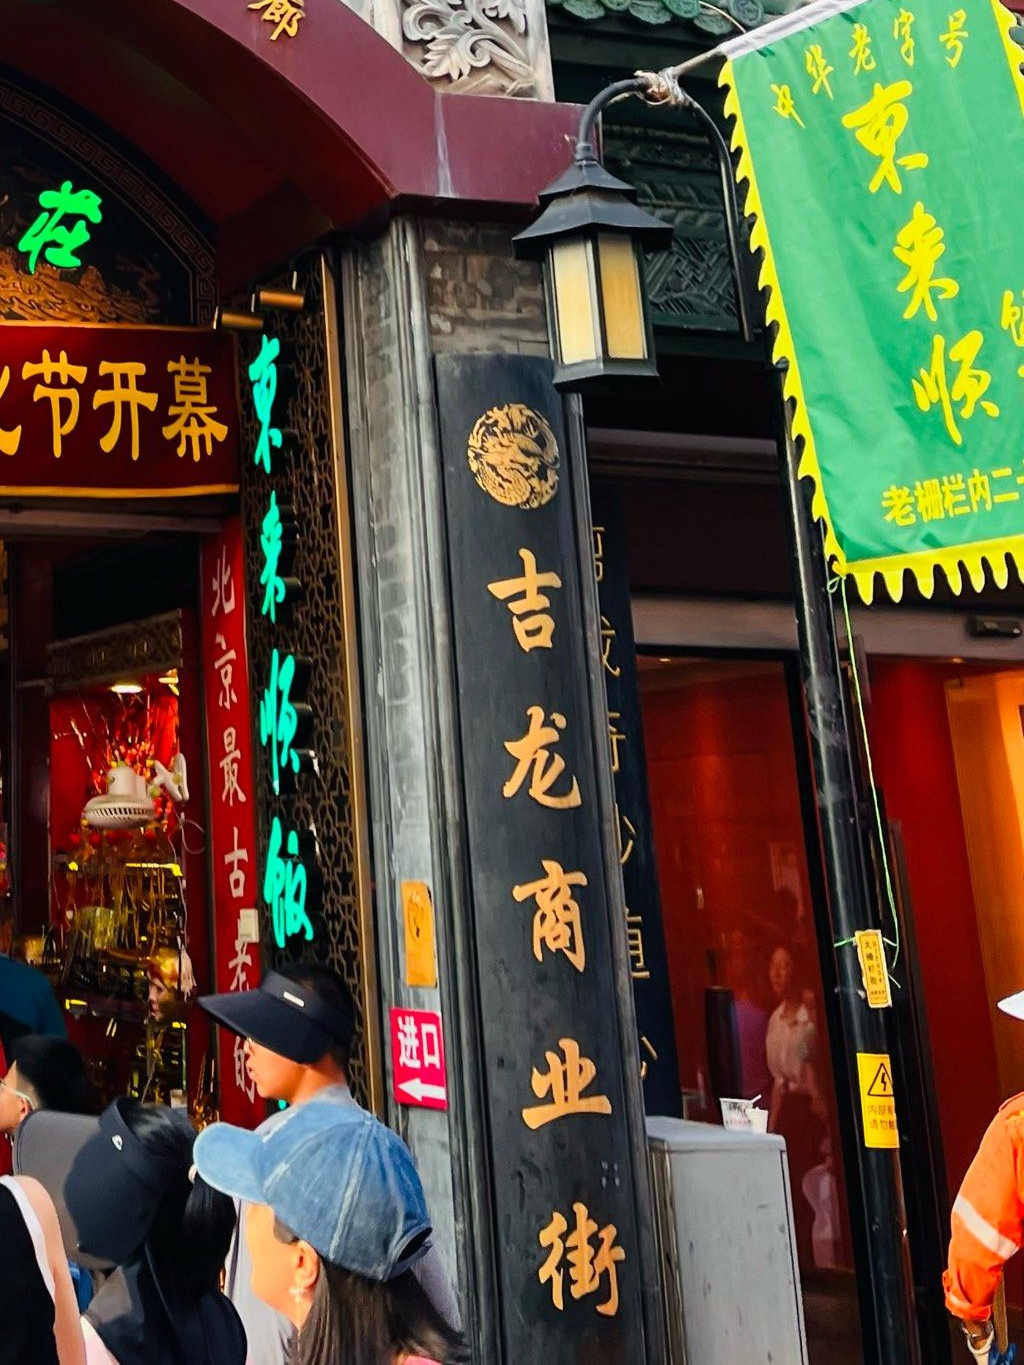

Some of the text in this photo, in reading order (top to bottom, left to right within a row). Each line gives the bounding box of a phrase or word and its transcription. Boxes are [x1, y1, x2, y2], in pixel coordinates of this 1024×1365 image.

[770, 8, 969, 129] 中华老字号
[881, 468, 1024, 526] 老栅栏内二
[486, 546, 626, 1318] 吉龙商业街
[397, 1015, 441, 1069] 进口
